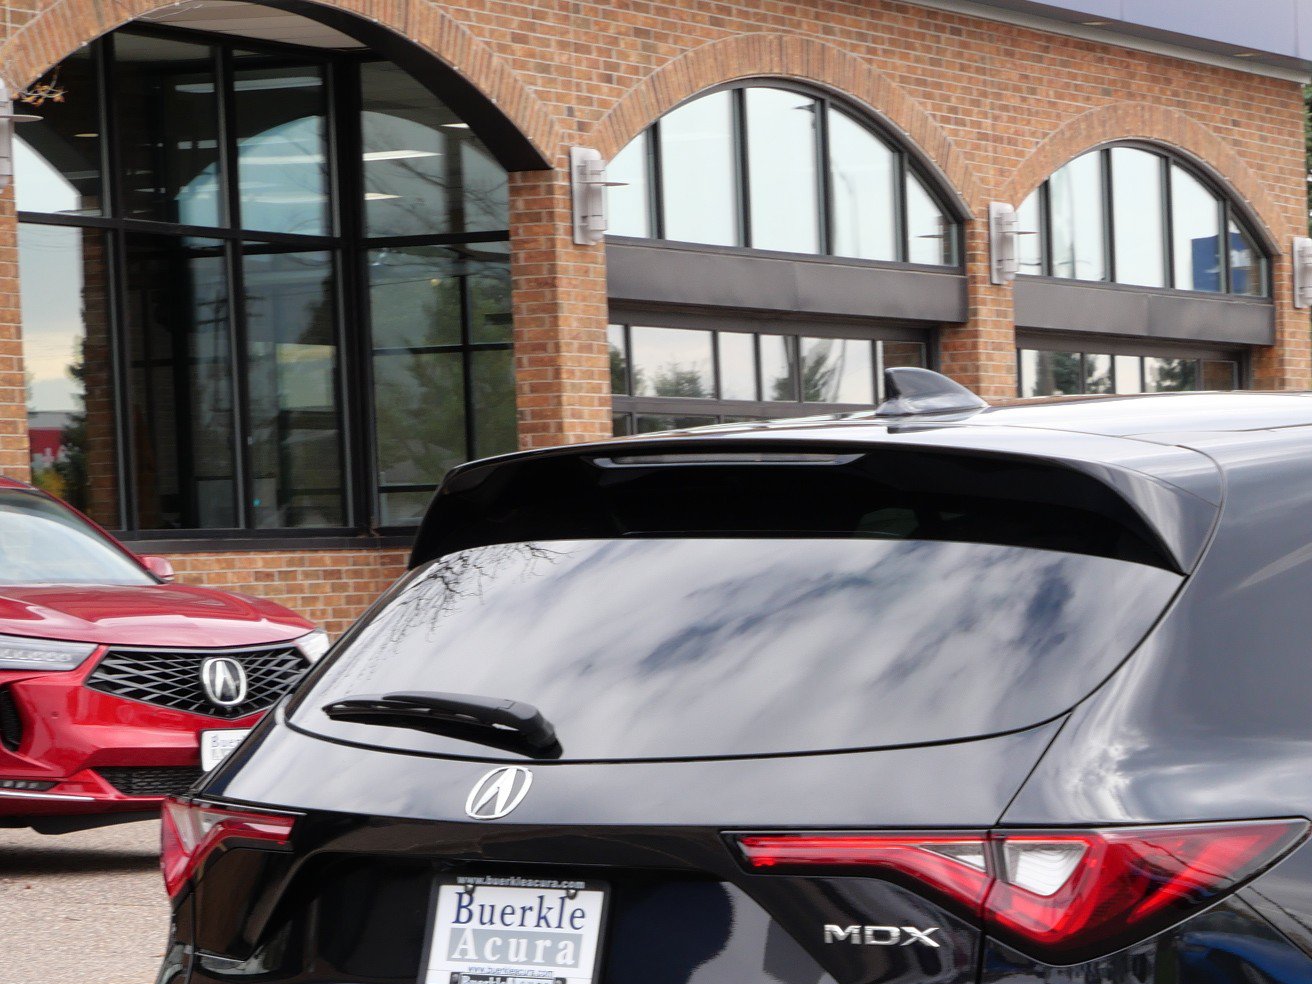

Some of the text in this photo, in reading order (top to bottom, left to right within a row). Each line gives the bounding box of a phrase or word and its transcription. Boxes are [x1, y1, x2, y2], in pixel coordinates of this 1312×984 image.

[457, 875, 586, 889] www.buerkleacura.com
[452, 893, 586, 930] Buerkle
[451, 929, 575, 965] Acura
[823, 924, 940, 948] MDX
